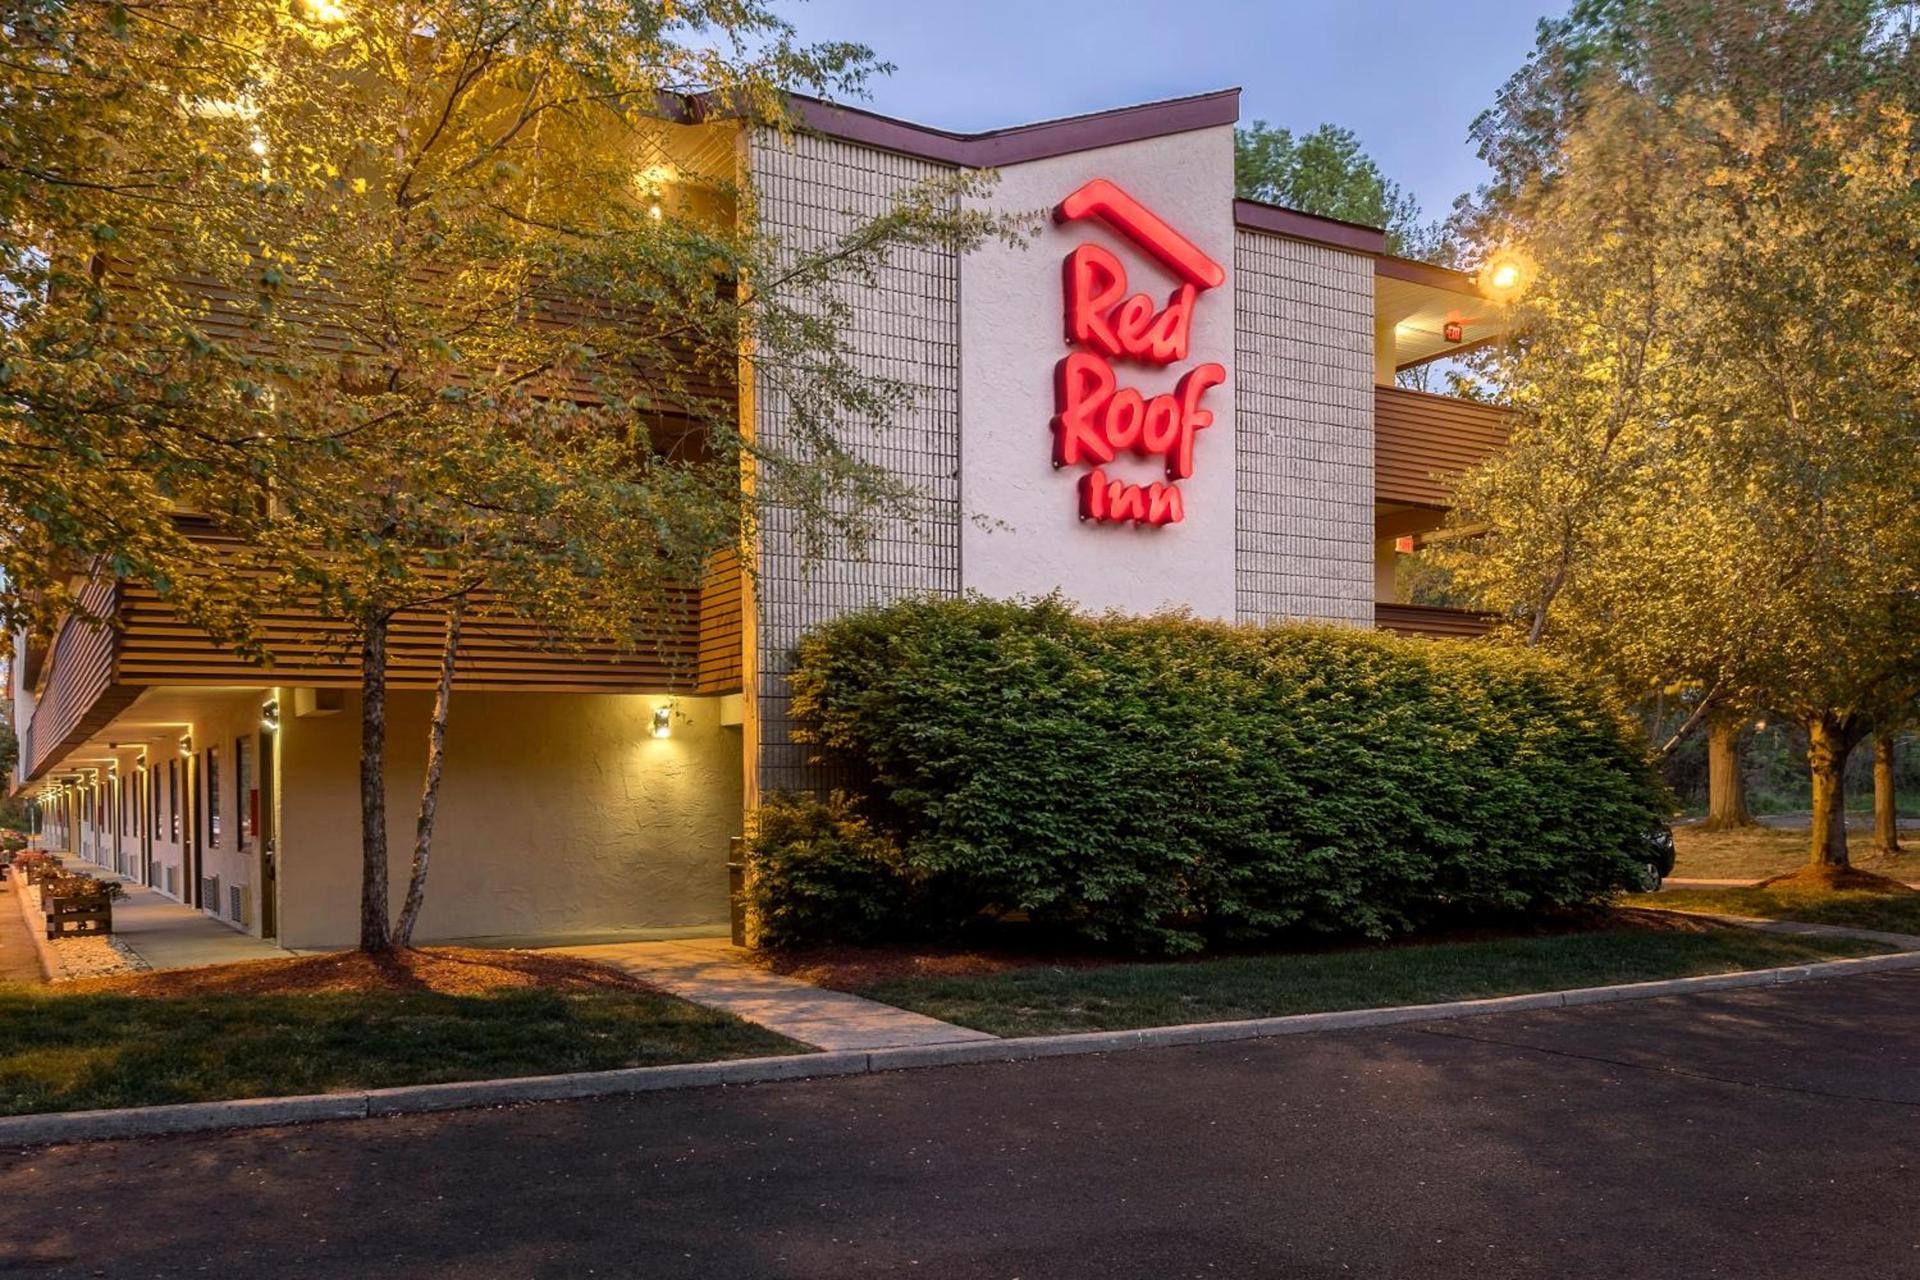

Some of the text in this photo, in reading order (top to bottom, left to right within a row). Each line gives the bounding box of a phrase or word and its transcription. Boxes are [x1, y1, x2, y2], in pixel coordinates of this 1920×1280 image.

[1071, 243, 1196, 359] Red
[1060, 351, 1226, 479] Roof
[1087, 468, 1184, 523] Inn
